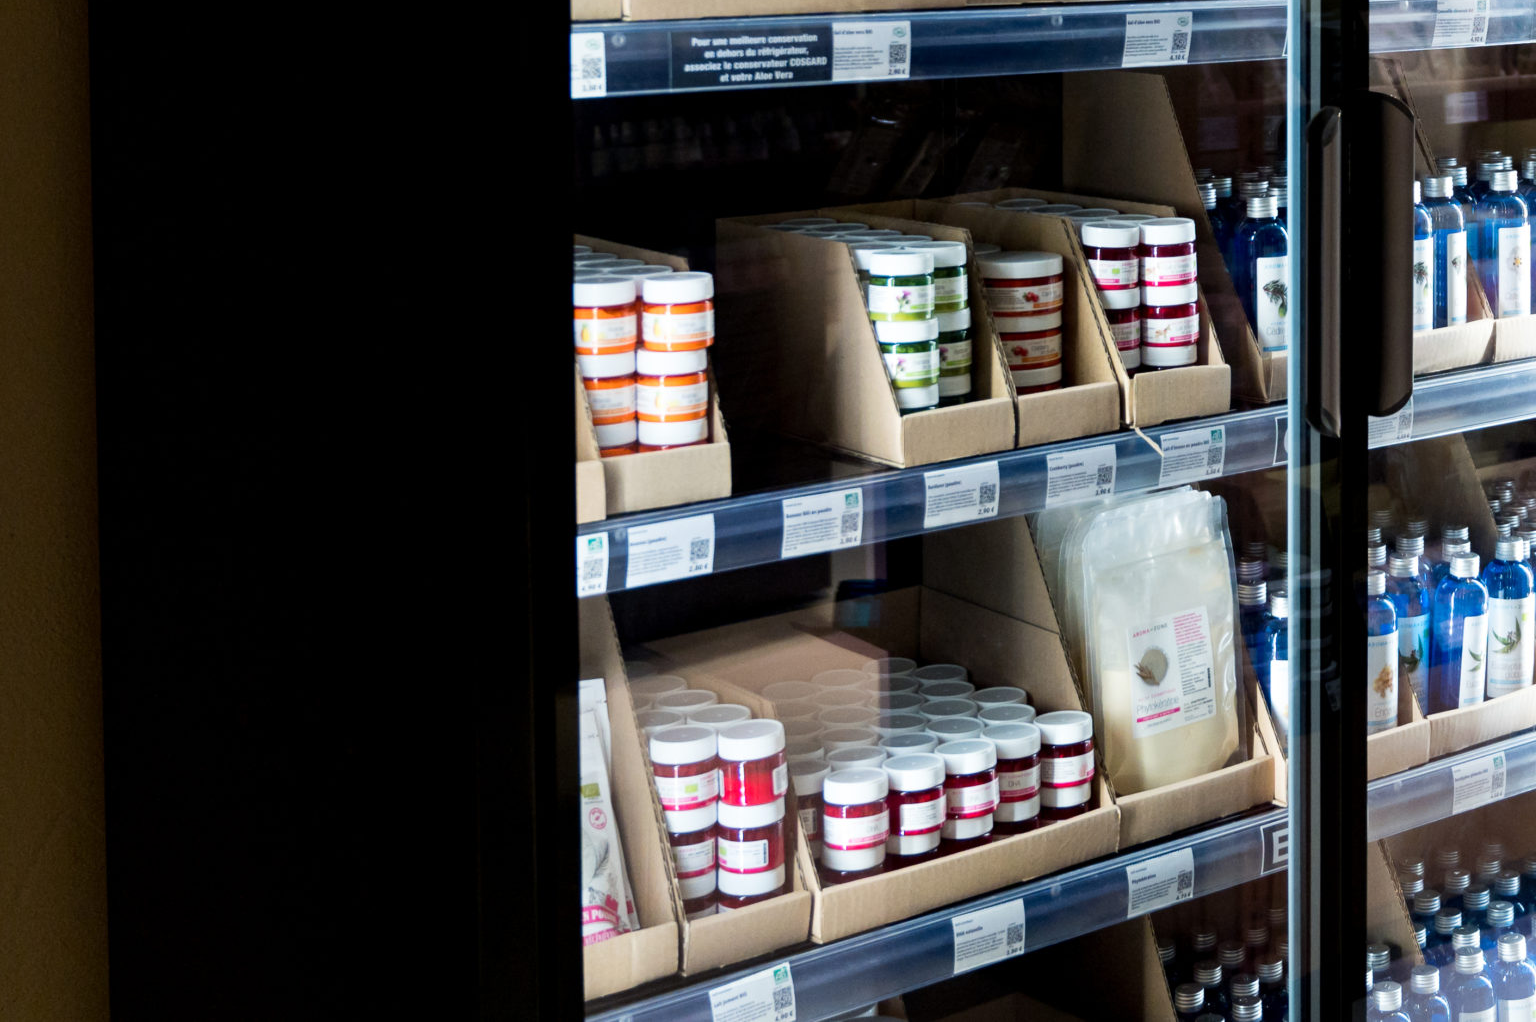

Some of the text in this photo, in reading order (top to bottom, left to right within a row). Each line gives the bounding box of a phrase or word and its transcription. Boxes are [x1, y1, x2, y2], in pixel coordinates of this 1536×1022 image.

[691, 33, 818, 47] Pour une meilleure conservation
[704, 45, 810, 59] en dehors du réfrigérateur,
[684, 62, 722, 72] associez
[723, 61, 732, 70] le
[733, 59, 788, 70] conservateur
[789, 56, 828, 67] COSGARD
[719, 70, 794, 82] et votre Aloe Vera
